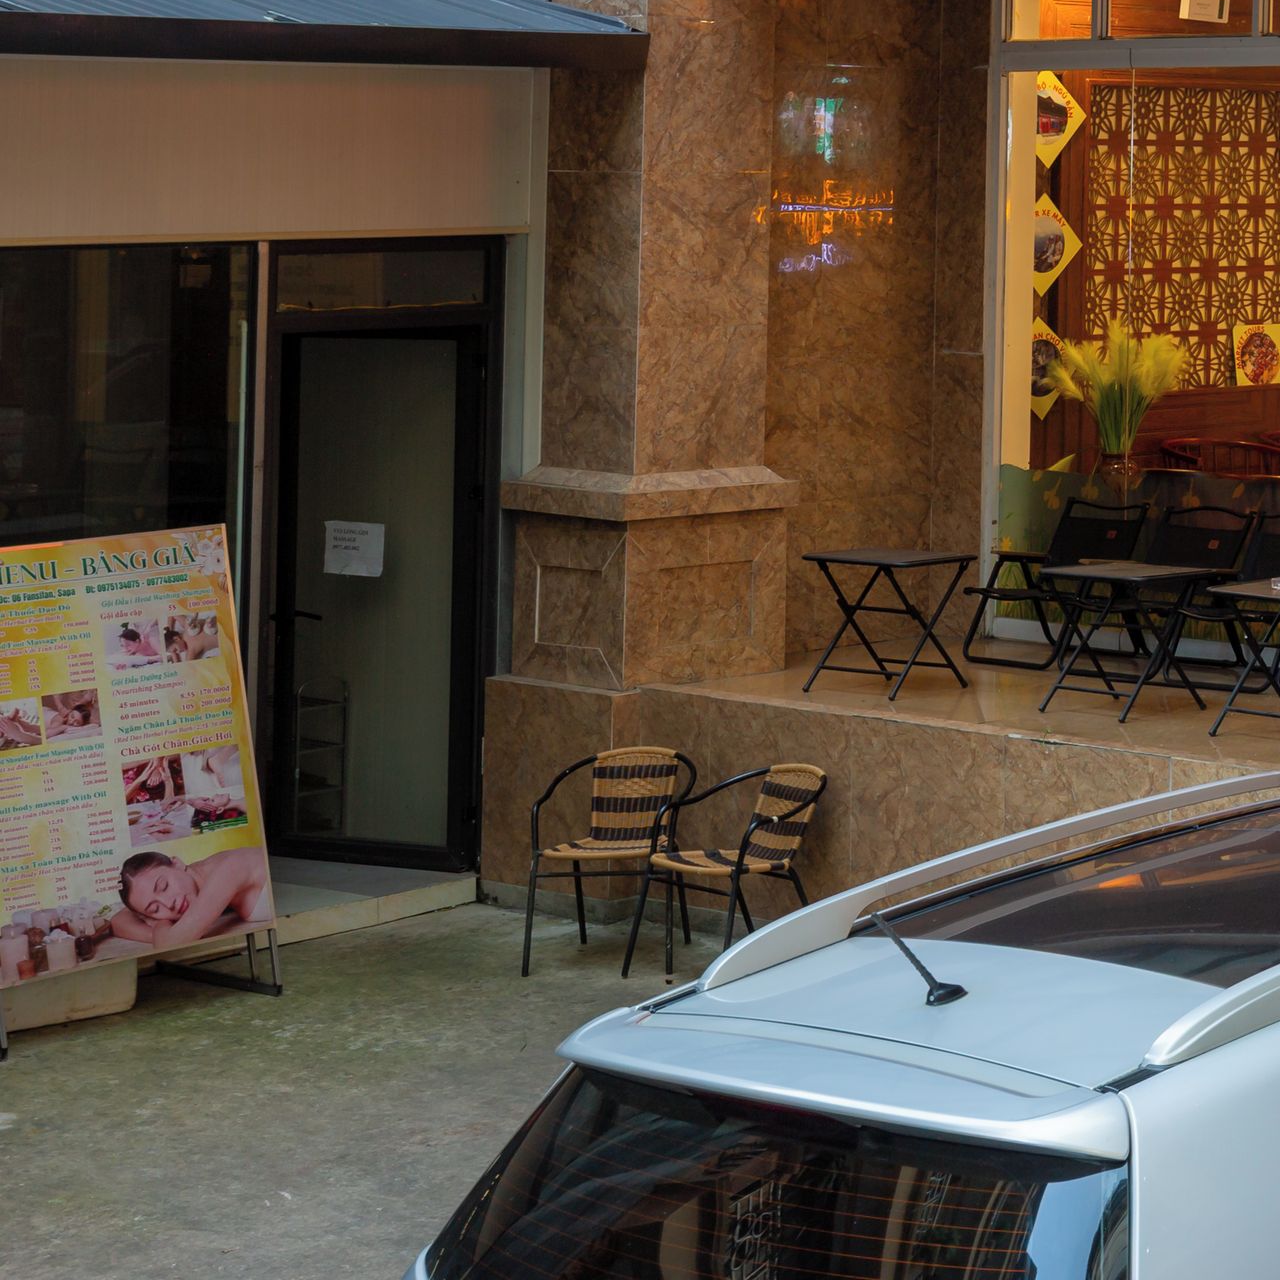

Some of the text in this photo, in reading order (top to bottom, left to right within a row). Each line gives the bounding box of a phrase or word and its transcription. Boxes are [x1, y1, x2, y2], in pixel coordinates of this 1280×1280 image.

[0, 542, 197, 586] ENU BẢNG GIÁ
[57, 588, 76, 598] Sapa
[130, 698, 159, 708] minutes
[131, 709, 161, 719] minutes
[35, 798, 70, 809] massage
[72, 793, 92, 802] With
[93, 790, 107, 799] Oil
